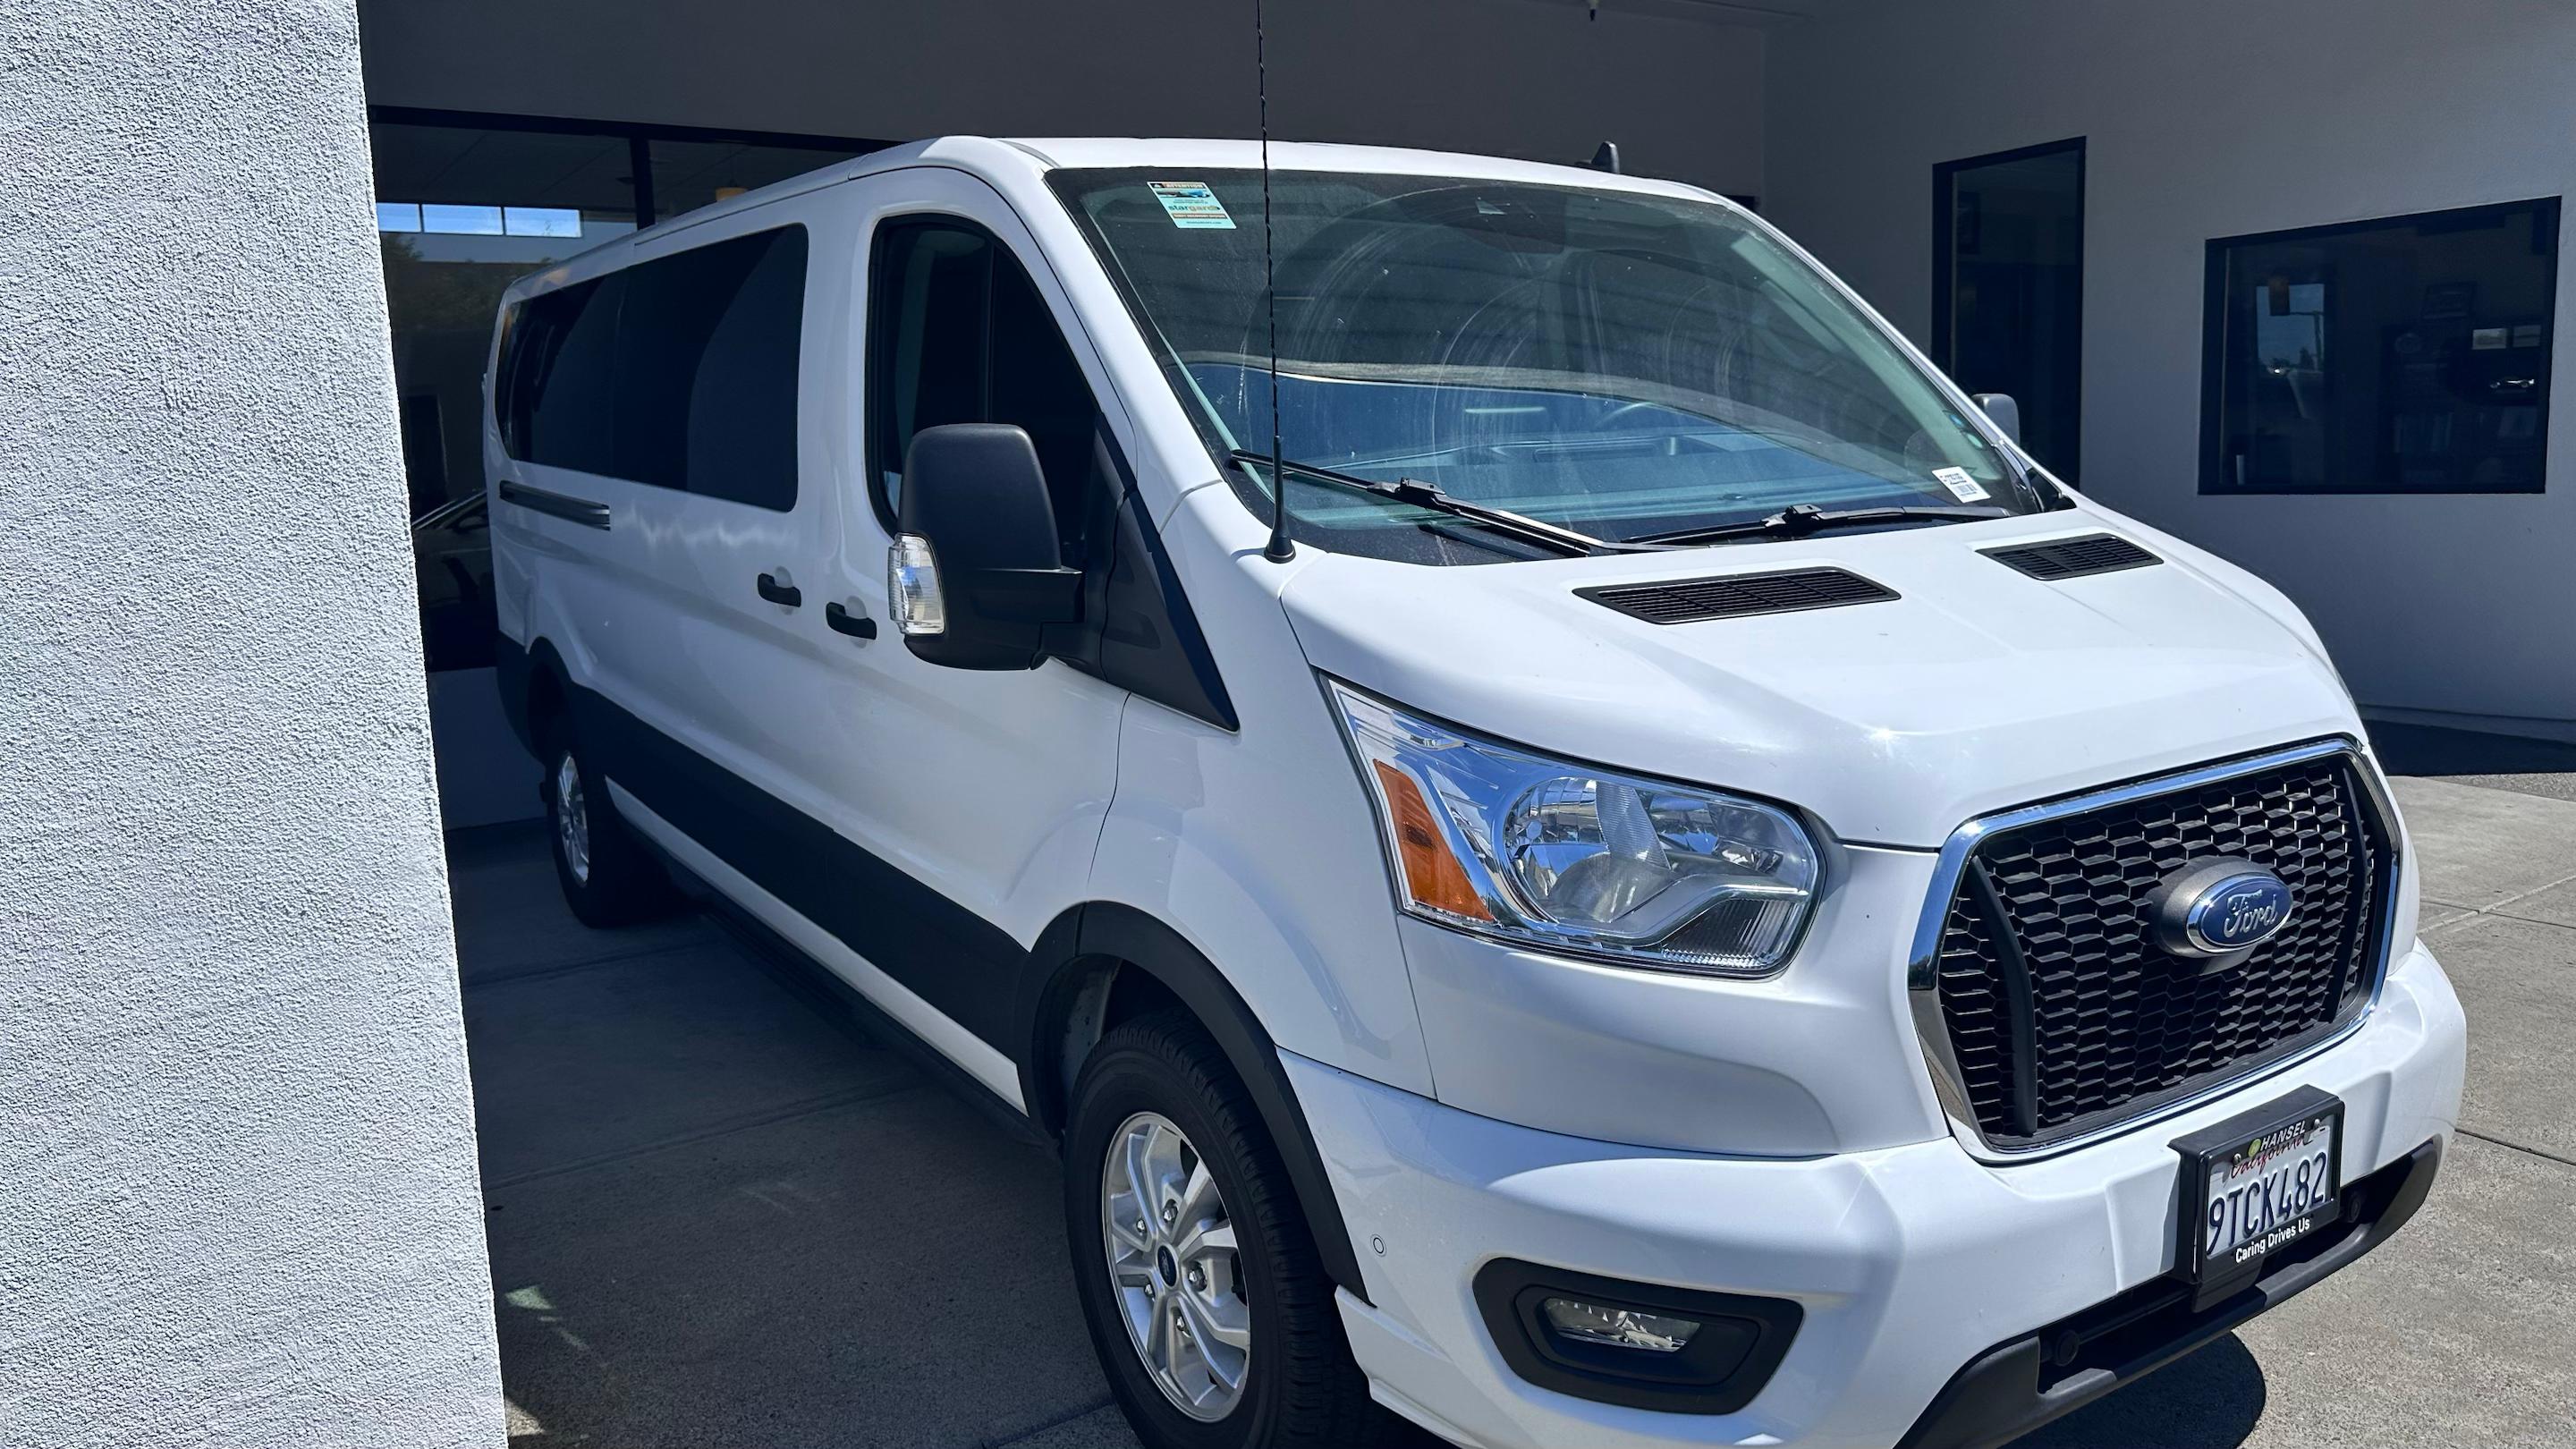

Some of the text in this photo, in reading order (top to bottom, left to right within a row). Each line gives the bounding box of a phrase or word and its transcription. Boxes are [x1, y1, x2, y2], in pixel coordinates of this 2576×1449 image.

[2224, 889, 2278, 937] Ford
[2260, 1121, 2306, 1151] HANSEL
[2207, 1151, 2327, 1254] 9TCK482
[2235, 1217, 2310, 1263] Caring Drives Us
